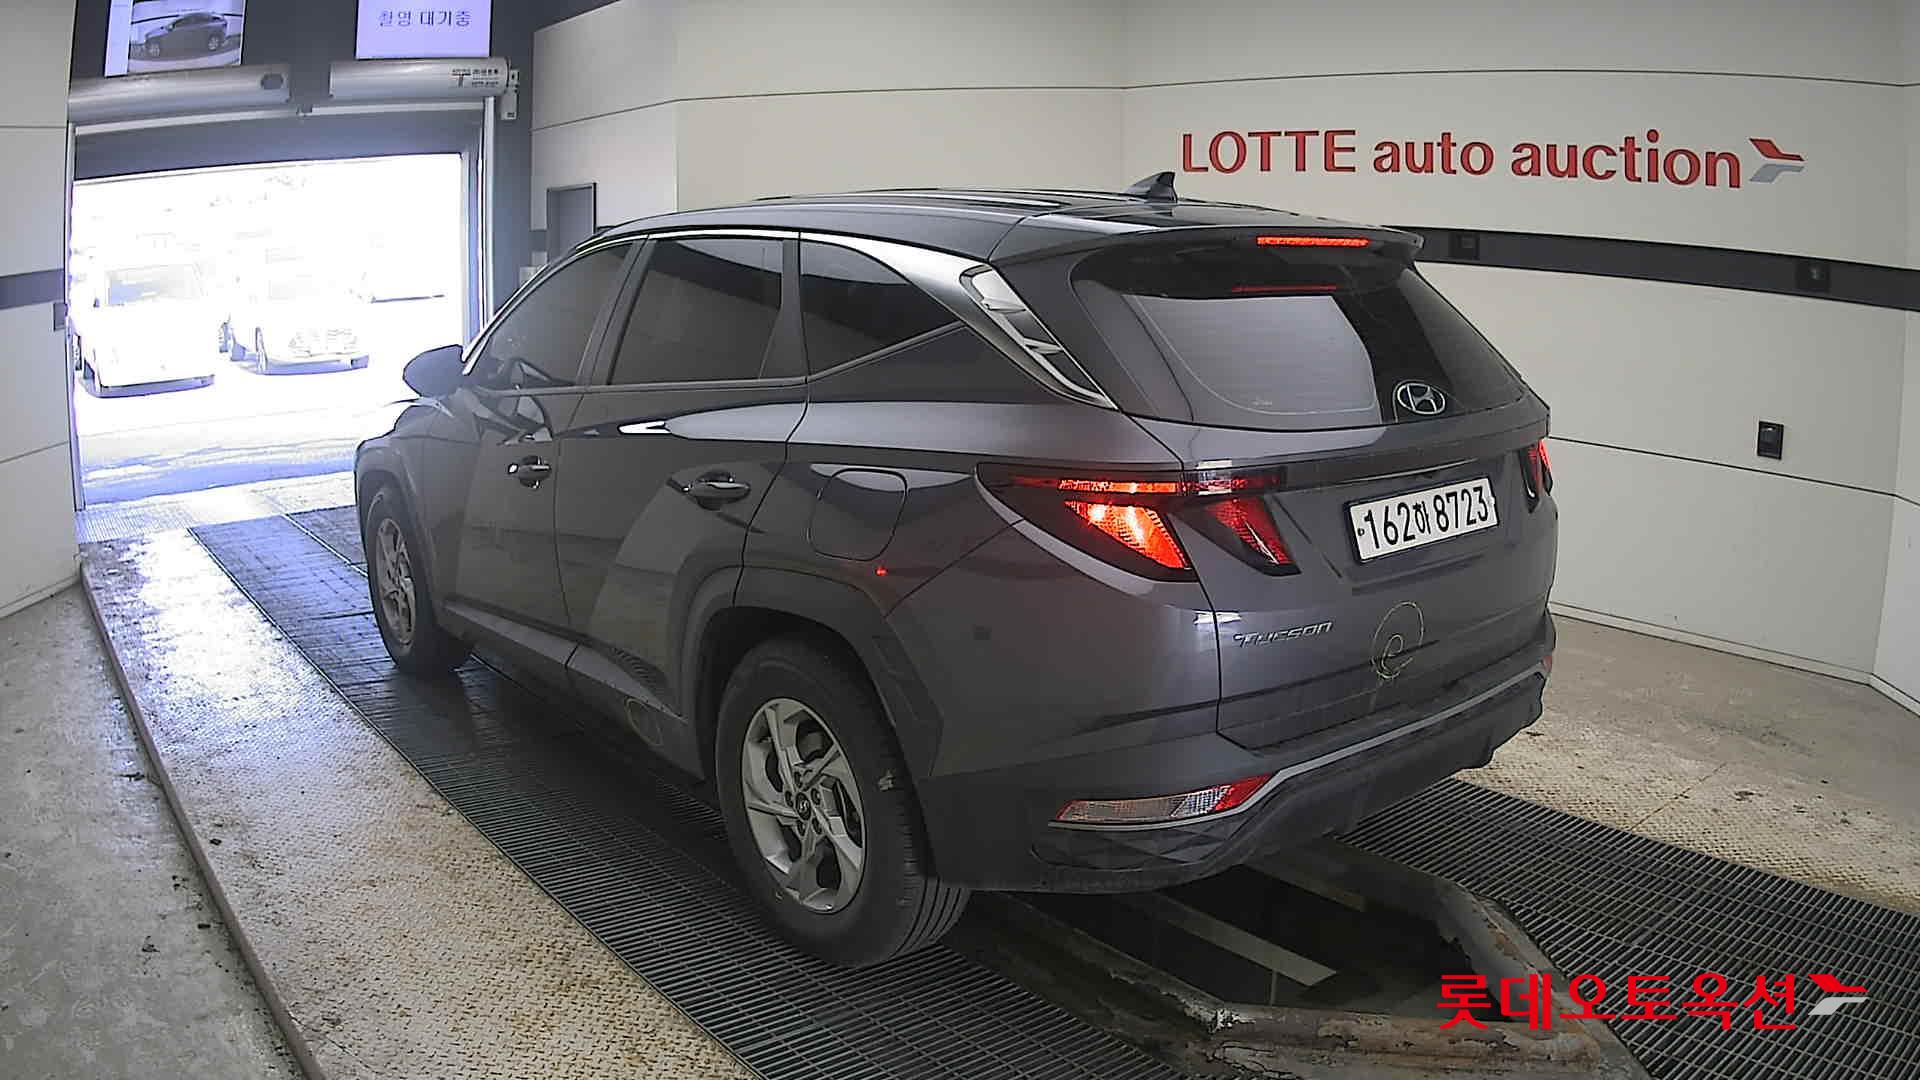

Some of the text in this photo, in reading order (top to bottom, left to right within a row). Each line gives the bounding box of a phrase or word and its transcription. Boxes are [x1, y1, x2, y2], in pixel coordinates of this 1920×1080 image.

[420, 10, 472, 27] 대기중
[1182, 129, 1740, 189] LOTTE auto auction
